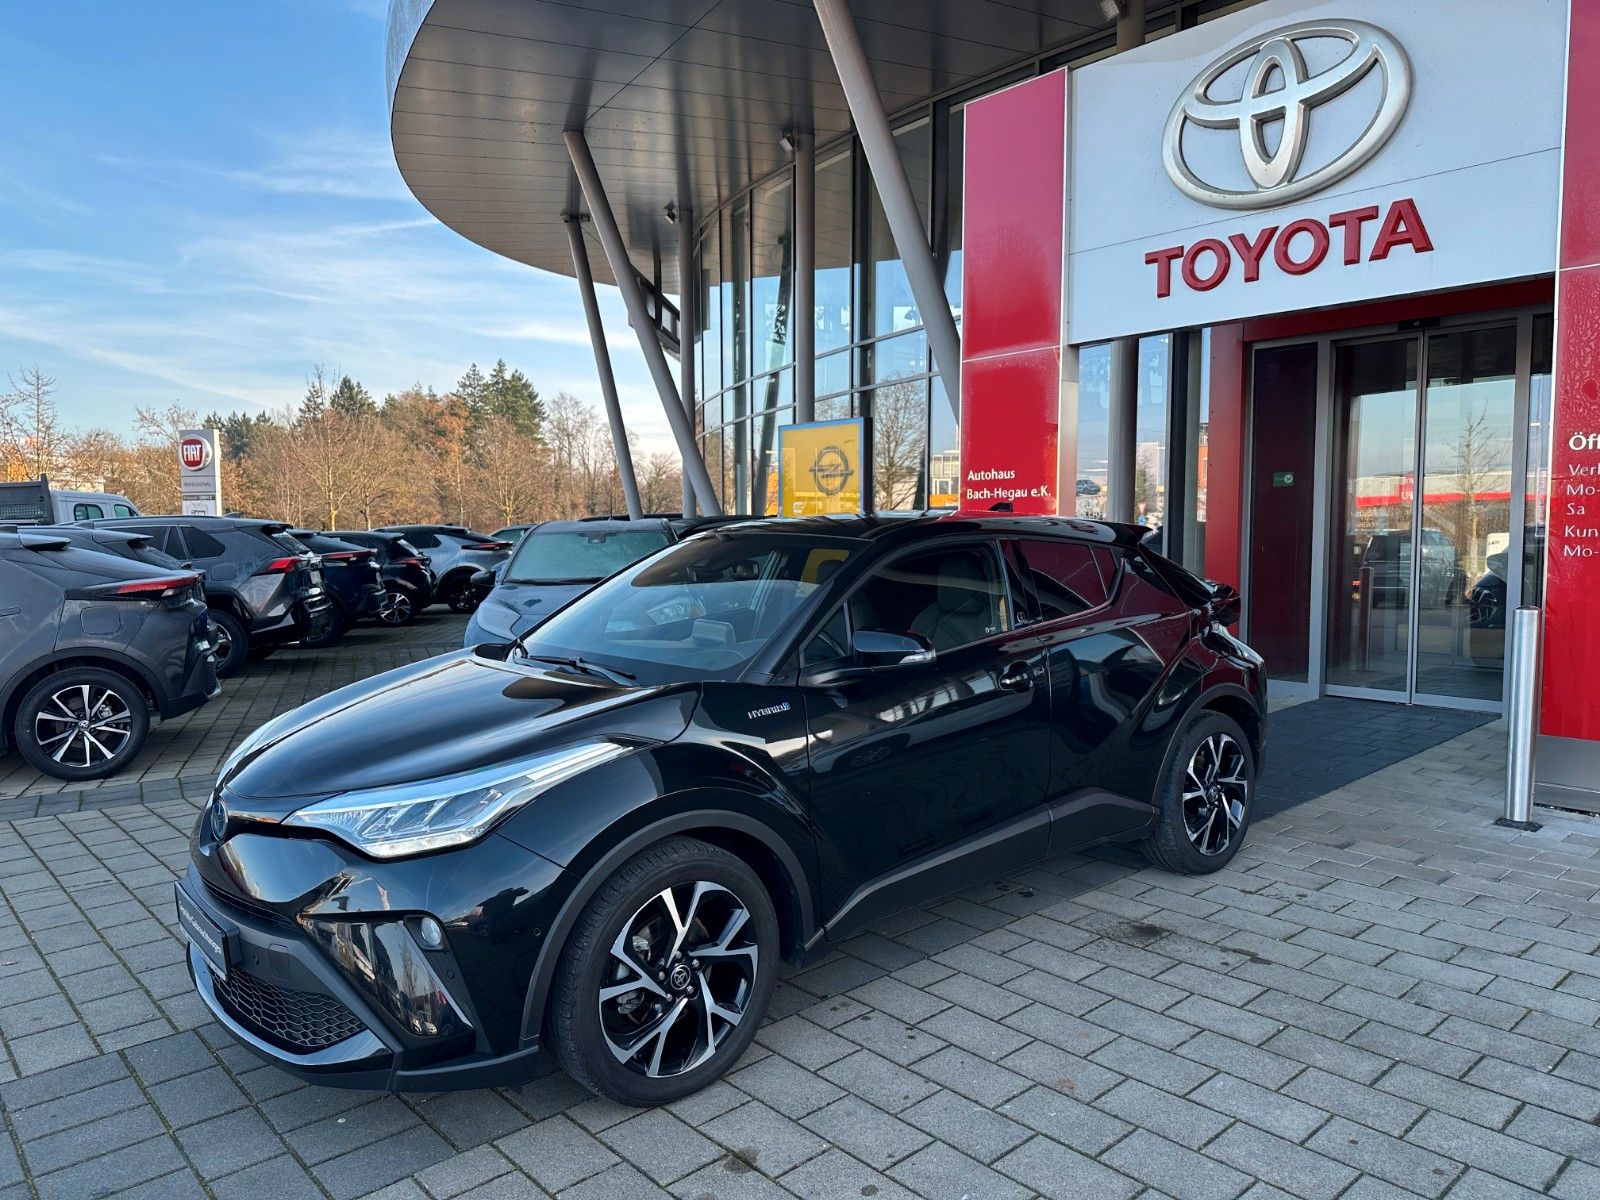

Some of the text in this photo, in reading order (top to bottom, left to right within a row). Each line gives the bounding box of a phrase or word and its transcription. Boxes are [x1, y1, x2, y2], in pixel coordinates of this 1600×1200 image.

[1144, 198, 1434, 299] TOYOTA
[183, 444, 202, 462] FIAT
[967, 468, 1016, 481] Autohaus
[1568, 463, 1600, 477] Ver
[966, 485, 1052, 501] Bach-Hegau e.K.
[1566, 502, 1586, 516] Sa
[1564, 525, 1599, 538] Kun
[1563, 544, 1600, 557] Mo-
[747, 703, 785, 719] HYBRID
